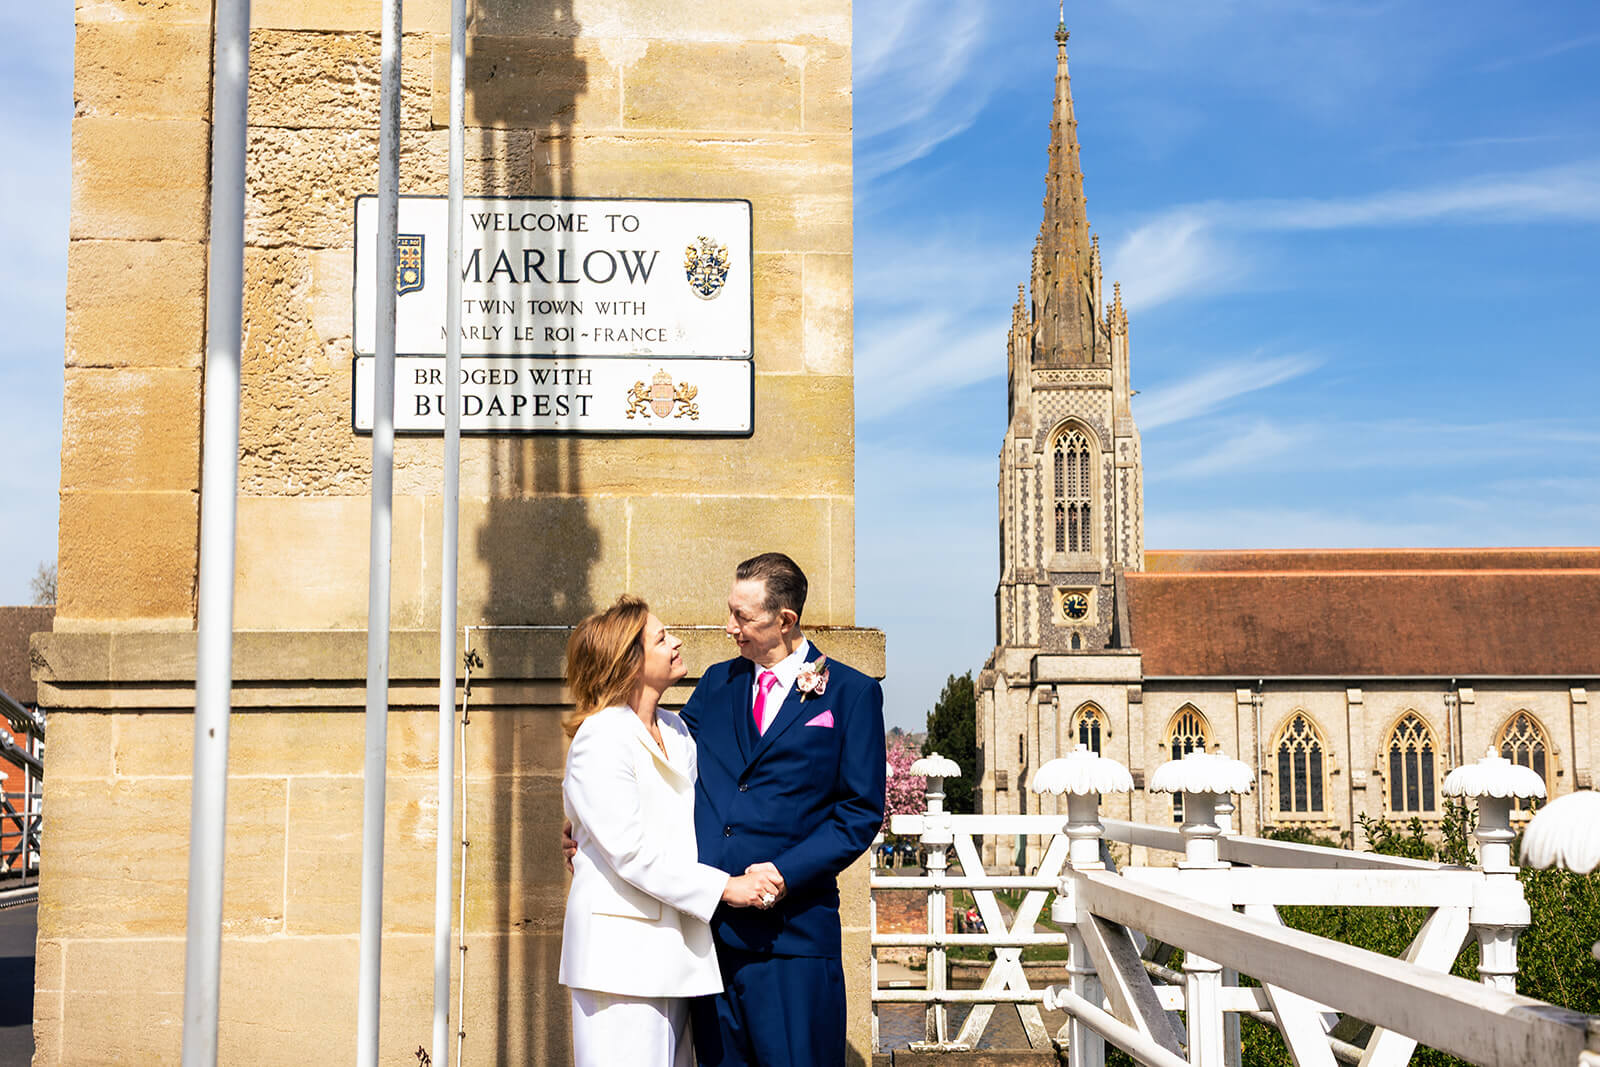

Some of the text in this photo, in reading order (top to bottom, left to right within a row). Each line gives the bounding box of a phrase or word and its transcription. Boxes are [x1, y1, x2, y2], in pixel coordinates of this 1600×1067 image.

[470, 213, 640, 232] WELCOME TO
[461, 248, 660, 284] MARLOW
[463, 300, 646, 315] TWIN TOWN WITH
[514, 326, 534, 341] LE
[544, 327, 575, 342] ROI
[594, 328, 668, 342] FRANCE
[414, 368, 593, 386] BRDGED WITH
